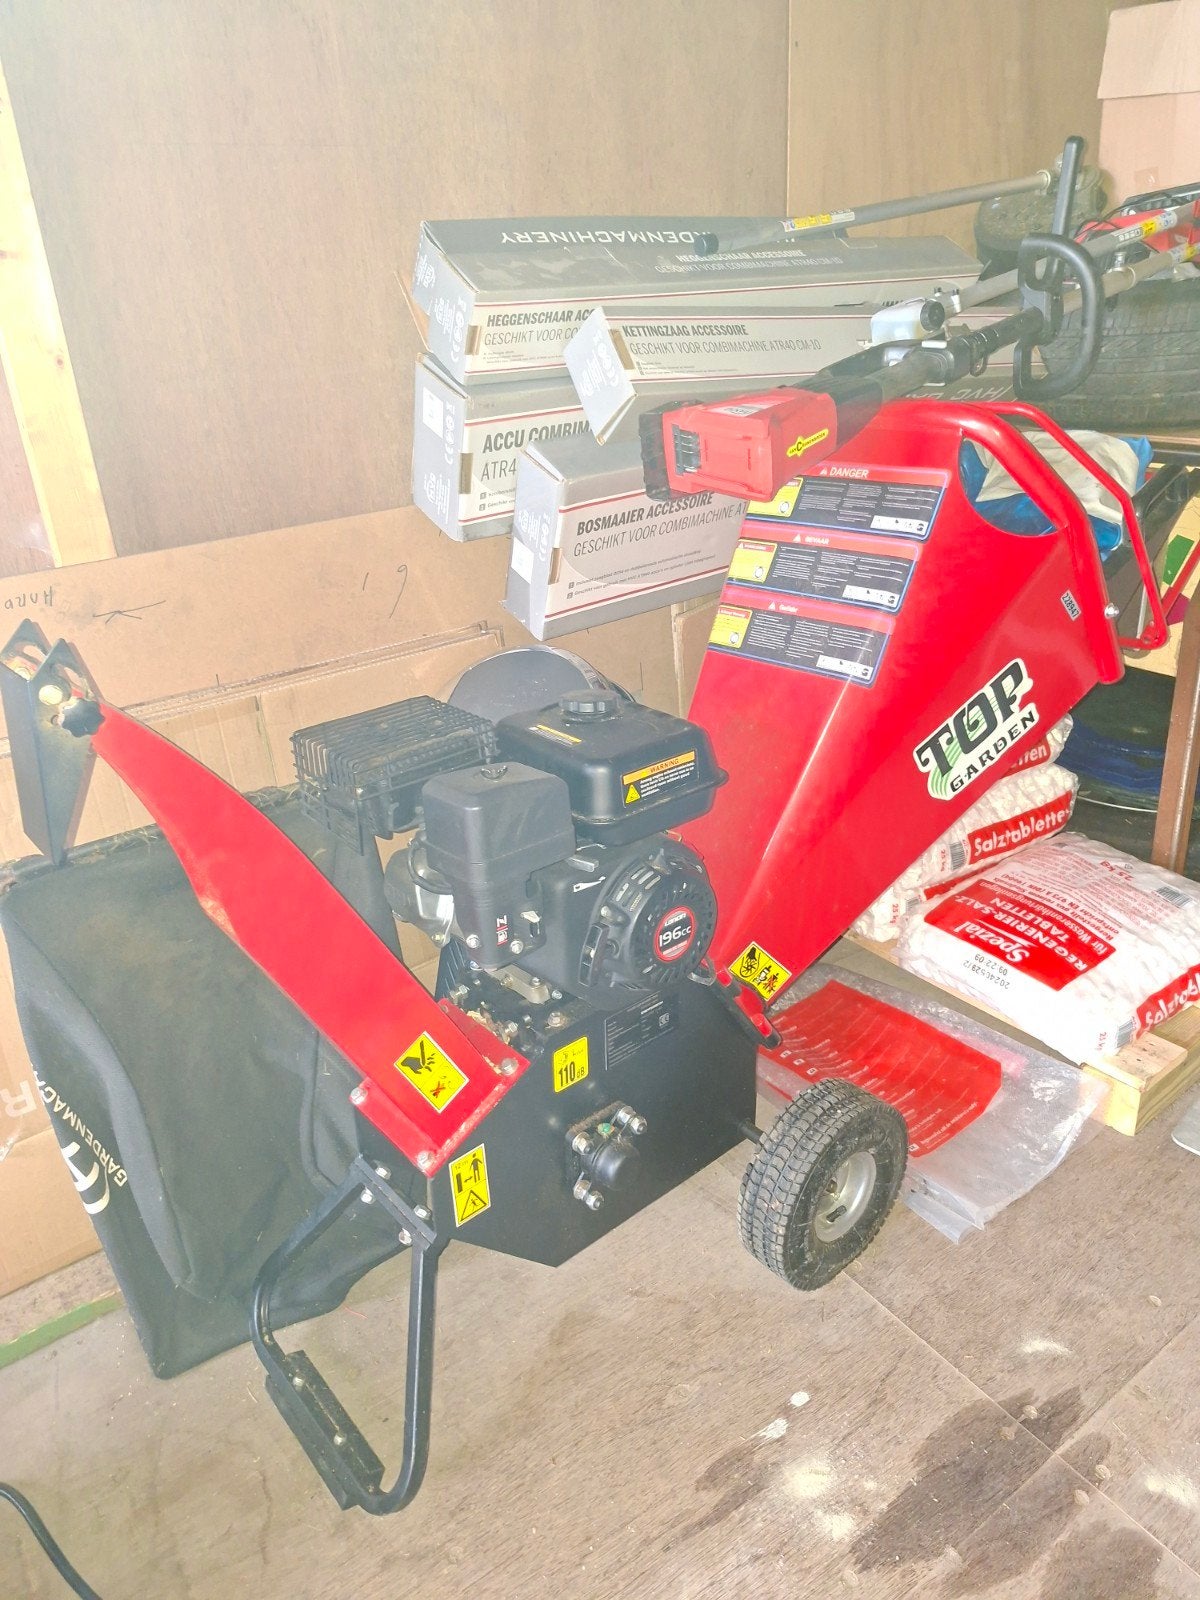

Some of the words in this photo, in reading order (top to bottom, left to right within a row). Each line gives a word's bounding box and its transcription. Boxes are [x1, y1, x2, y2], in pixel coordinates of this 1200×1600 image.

[501, 230, 711, 244] DENMACHINERY
[486, 311, 573, 327] HEGGENSCHAAR
[621, 324, 690, 338] KETTINGZAAG
[691, 323, 748, 337] ACCESSOIRE
[484, 327, 533, 346] GESCHIKT
[536, 327, 561, 342] VOOR
[629, 340, 674, 356] GESCHIKT
[675, 340, 701, 355] VOOR
[702, 340, 767, 355] COMBIMACHINE
[767, 339, 796, 352] ATR40
[796, 339, 823, 351] CM-10
[482, 430, 526, 454] ACCU
[481, 458, 517, 482] ATR4
[828, 467, 869, 479] DANGER
[576, 507, 644, 536] BOSMAAIER
[648, 492, 714, 519] ACCESSOIRE
[573, 530, 627, 557] GESCHIKT
[628, 525, 657, 542] VOOR
[658, 506, 734, 538] COMBIMACHINE
[915, 660, 1025, 778] TOP
[949, 710, 1036, 793] GARDEN
[650, 758, 679, 774] WARNING
[1116, 870, 1134, 881] 25
[991, 897, 1069, 943] TABLETTEN
[658, 924, 692, 948] 196cc
[953, 920, 1030, 963] Spezial
[954, 894, 1088, 971] REGENERIER-SALZ-
[1090, 939, 1108, 956] für
[557, 1060, 576, 1088] 110
[576, 1066, 586, 1078] dB
